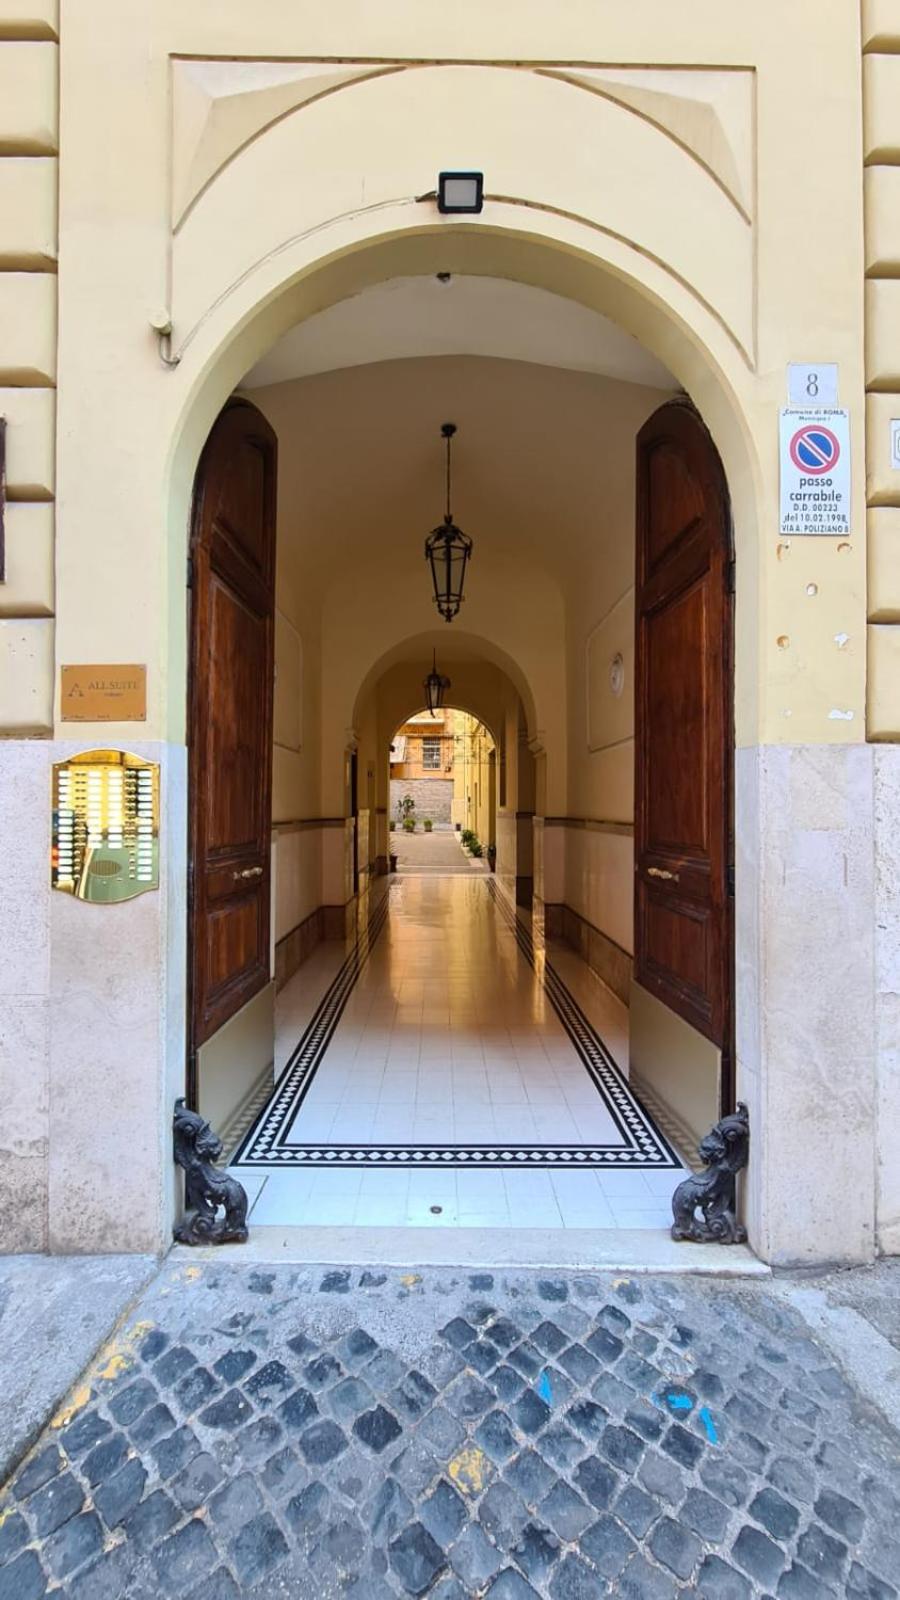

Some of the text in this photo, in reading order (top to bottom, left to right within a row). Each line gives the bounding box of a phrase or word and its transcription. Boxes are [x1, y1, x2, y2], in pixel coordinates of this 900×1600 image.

[806, 372, 819, 397] 8
[800, 478, 833, 489] passo
[790, 489, 842, 501] carrabile
[784, 512, 799, 521] del
[804, 524, 843, 533] POLIZIANO
